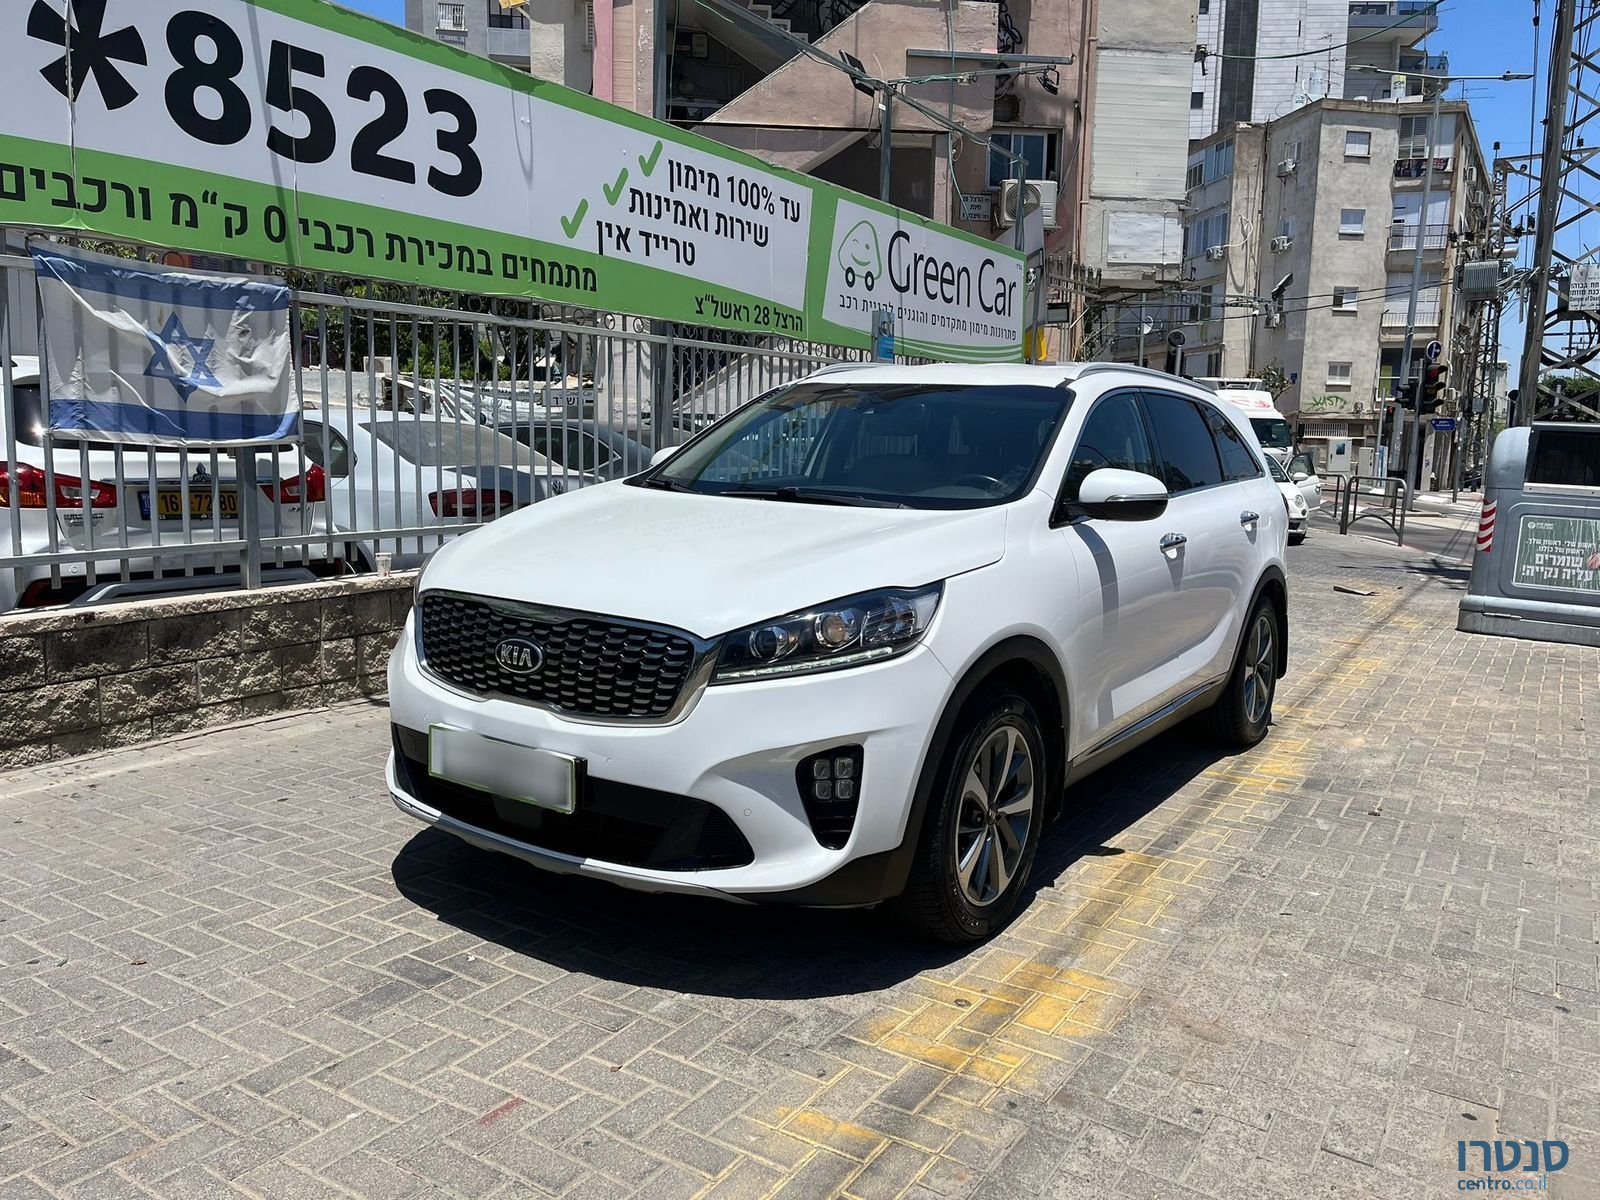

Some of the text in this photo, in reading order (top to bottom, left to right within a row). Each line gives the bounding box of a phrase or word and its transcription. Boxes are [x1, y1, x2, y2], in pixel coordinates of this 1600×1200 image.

[0, 163, 152, 221] ורכבים
[668, 159, 800, 222] עד 100% מימון
[264, 205, 287, 243] 0
[629, 187, 768, 247] שירות ואמינות
[299, 218, 374, 258] רכבי
[386, 232, 493, 276] במכירת
[597, 220, 695, 266] טרייד אין
[502, 253, 597, 292] מתמחים
[888, 230, 1016, 317] Green Car
[695, 293, 803, 332] הרצל 28 ראשל"צ
[839, 294, 858, 311] רכב
[897, 306, 928, 324] והוגנים
[931, 313, 967, 332] מתקדמים
[969, 321, 988, 336] מימון
[990, 325, 1016, 341] פתרונות
[1522, 564, 1559, 579] נקייה!
[1535, 553, 1583, 568] שומרים
[501, 644, 532, 667] KIA
